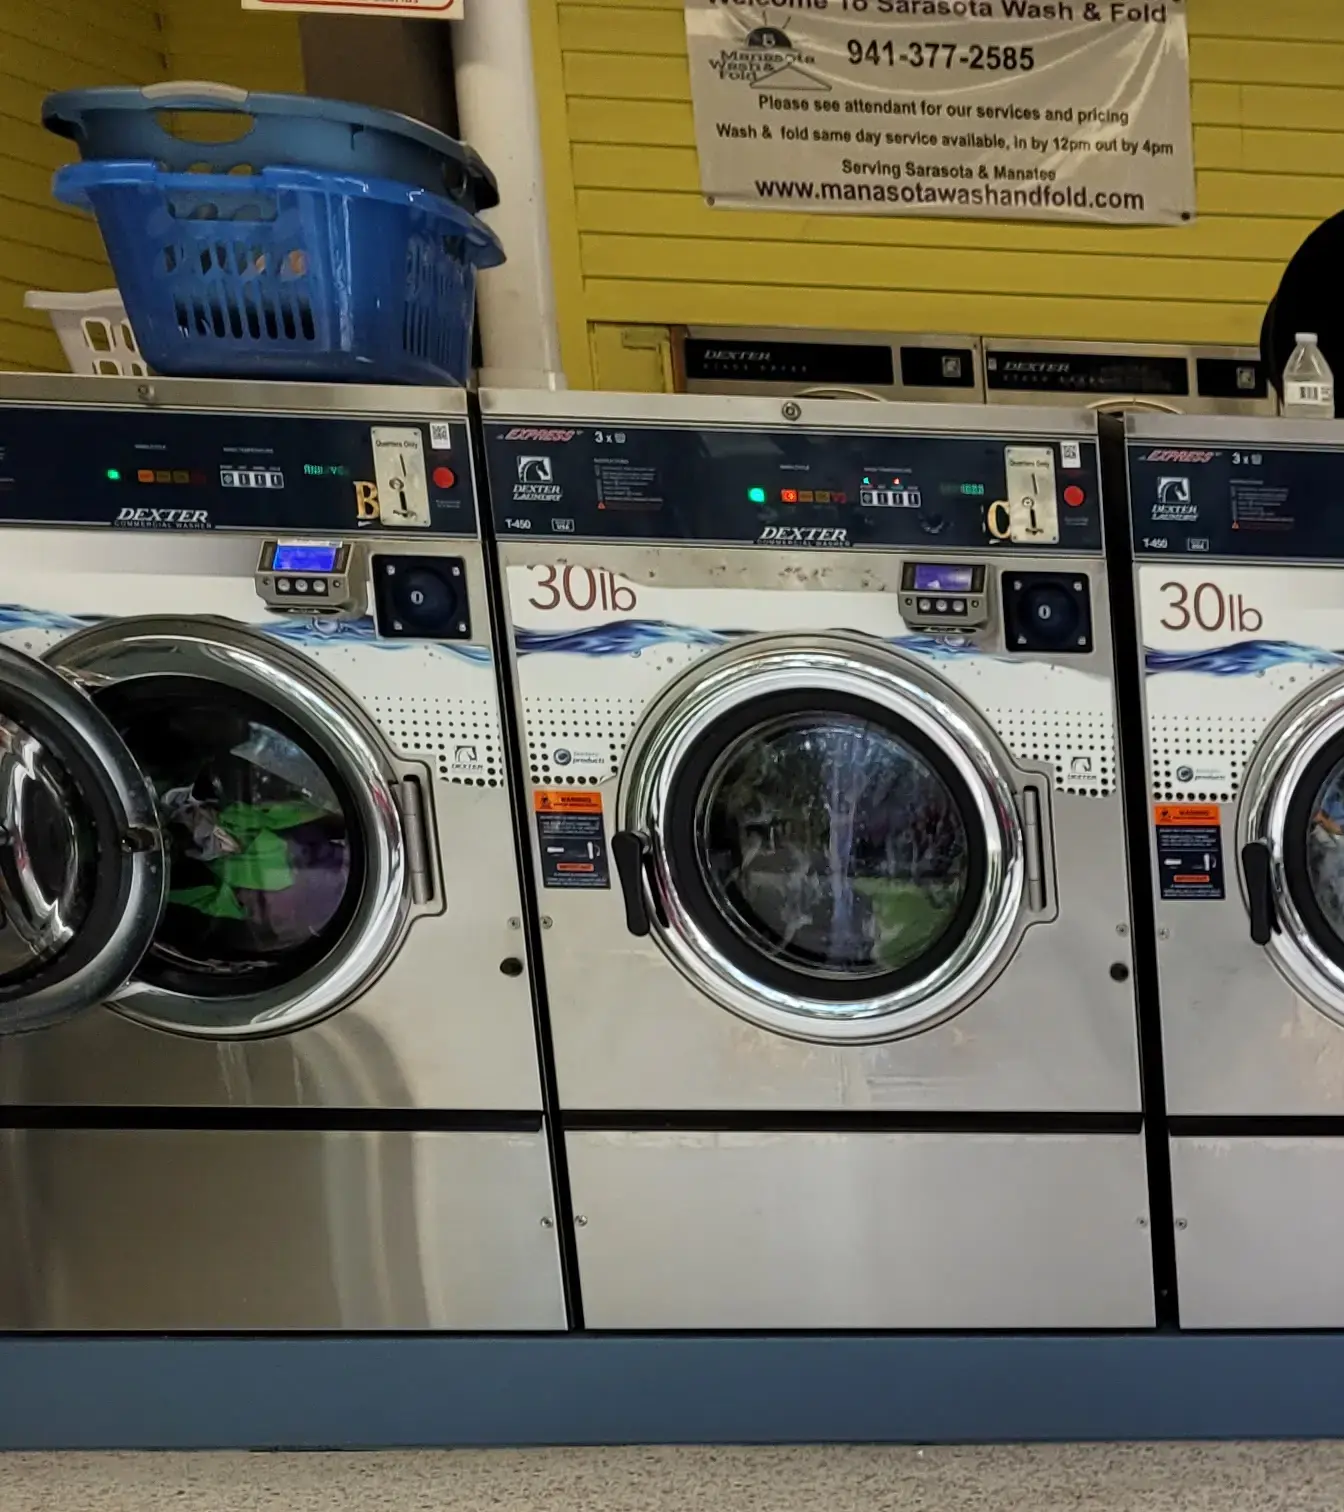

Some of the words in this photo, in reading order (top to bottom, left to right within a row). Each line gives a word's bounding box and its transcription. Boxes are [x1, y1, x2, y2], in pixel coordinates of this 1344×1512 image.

[877, 0, 992, 17] Sarasota
[1003, 1, 1073, 21] Wash
[1083, 3, 1101, 21] &
[1111, 3, 1167, 23] Fold
[847, 39, 1035, 71] 941-377-2585
[758, 94, 809, 111] Please
[814, 100, 840, 112] see
[845, 100, 917, 115] attendant
[920, 101, 943, 116] for
[946, 104, 972, 118] our
[977, 105, 1040, 121] services
[1045, 107, 1073, 121] and
[1077, 108, 1129, 126] pricing
[716, 122, 757, 139] Wash
[762, 125, 772, 139] &
[781, 126, 808, 141] fold
[812, 130, 851, 142] same
[856, 128, 881, 147] day
[885, 130, 937, 145] service
[942, 132, 1010, 150] available,
[1014, 136, 1027, 149] in
[1031, 136, 1049, 153] by
[1052, 136, 1091, 153] 12pm
[1095, 139, 1118, 152] out
[1122, 139, 1139, 155] by
[1142, 140, 1174, 157] 4pm
[842, 158, 901, 179] Serving
[905, 161, 973, 179] Sarasota
[978, 165, 989, 180] &
[994, 165, 1057, 181] Manatee
[755, 180, 1145, 211] www.manasotawashandfold.com
[1003, 361, 1070, 373] DEXTER
[505, 428, 576, 440] EXPRESS
[595, 431, 604, 443] 3
[353, 481, 380, 519] B
[513, 484, 560, 494] DEXTER
[116, 507, 208, 522] DEXTER
[505, 519, 531, 529] T-450
[759, 526, 847, 541] DEXTER
[528, 564, 637, 612] 30lb
[1160, 582, 1263, 632] 30lb
